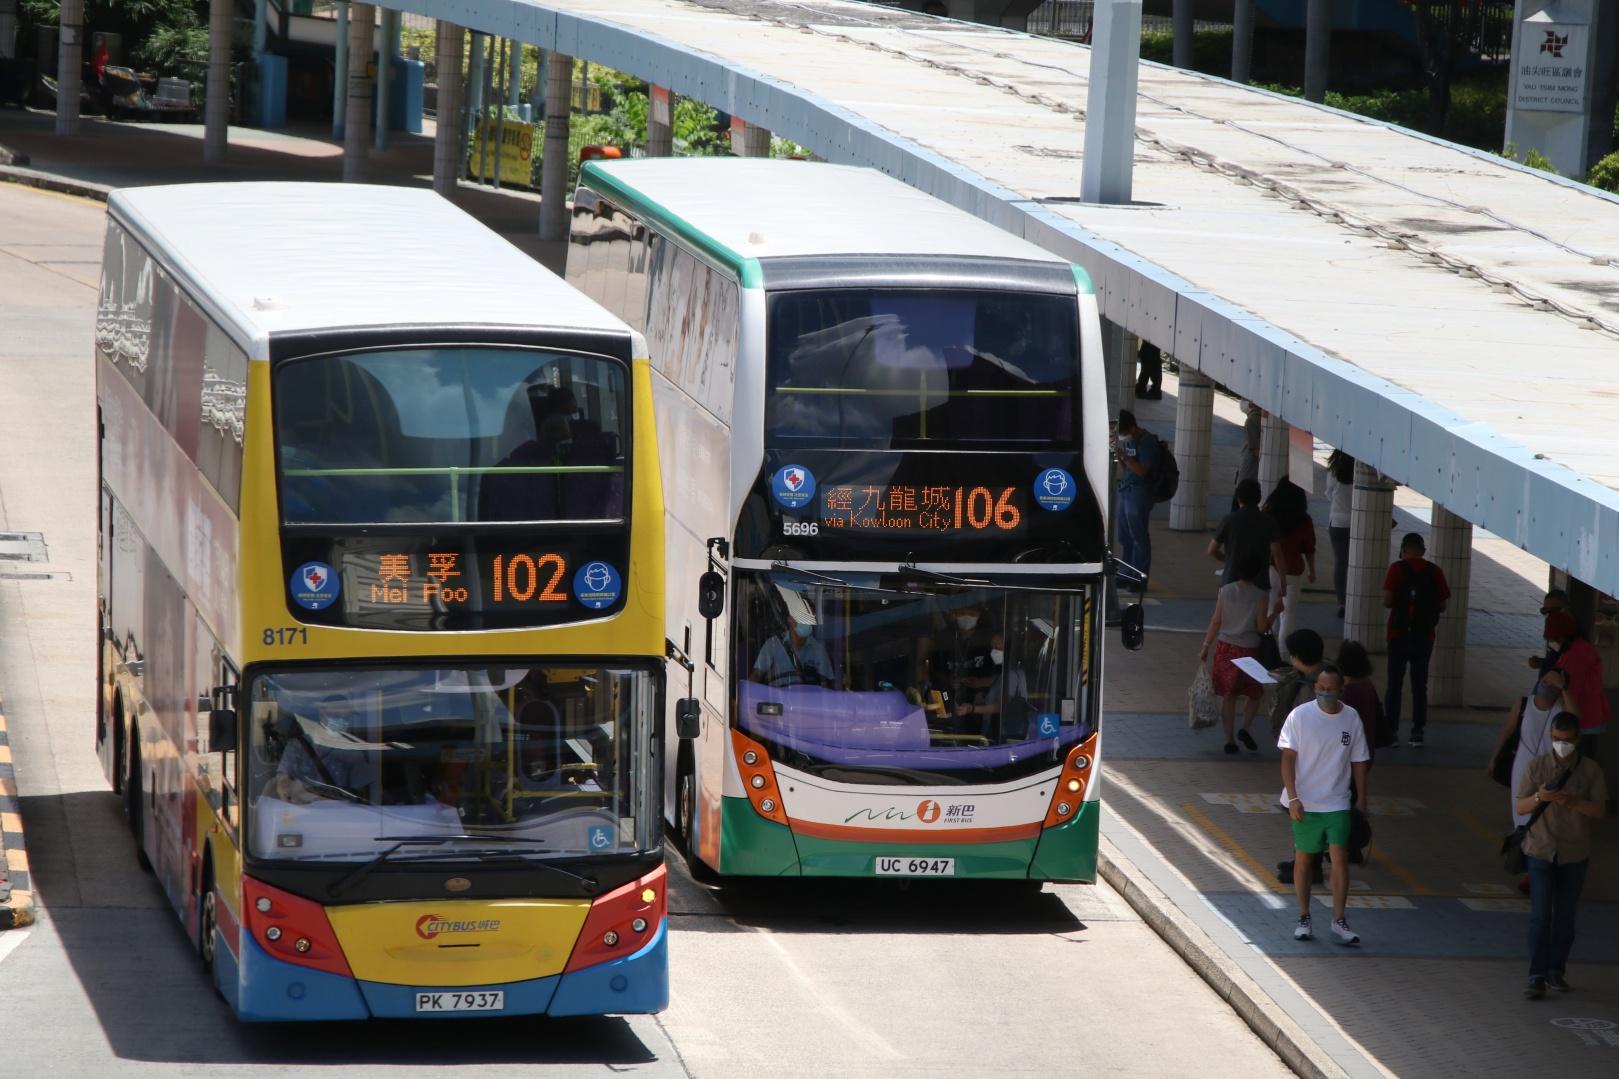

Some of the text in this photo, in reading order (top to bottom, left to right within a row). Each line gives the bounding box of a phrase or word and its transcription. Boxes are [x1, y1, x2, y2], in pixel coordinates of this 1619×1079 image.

[1518, 96, 1580, 105] DISTRICT COUNCIL
[954, 486, 1020, 530] 106
[783, 522, 819, 536] 5696
[825, 511, 951, 532] via Kowloon City
[494, 554, 567, 601] 102
[370, 583, 469, 603] Mei Foo
[263, 627, 308, 646] 8171
[945, 804, 975, 817] 新巴
[881, 859, 949, 874] UC 6947
[427, 920, 477, 934] CITYBUS
[419, 993, 499, 1009] PK 7937
